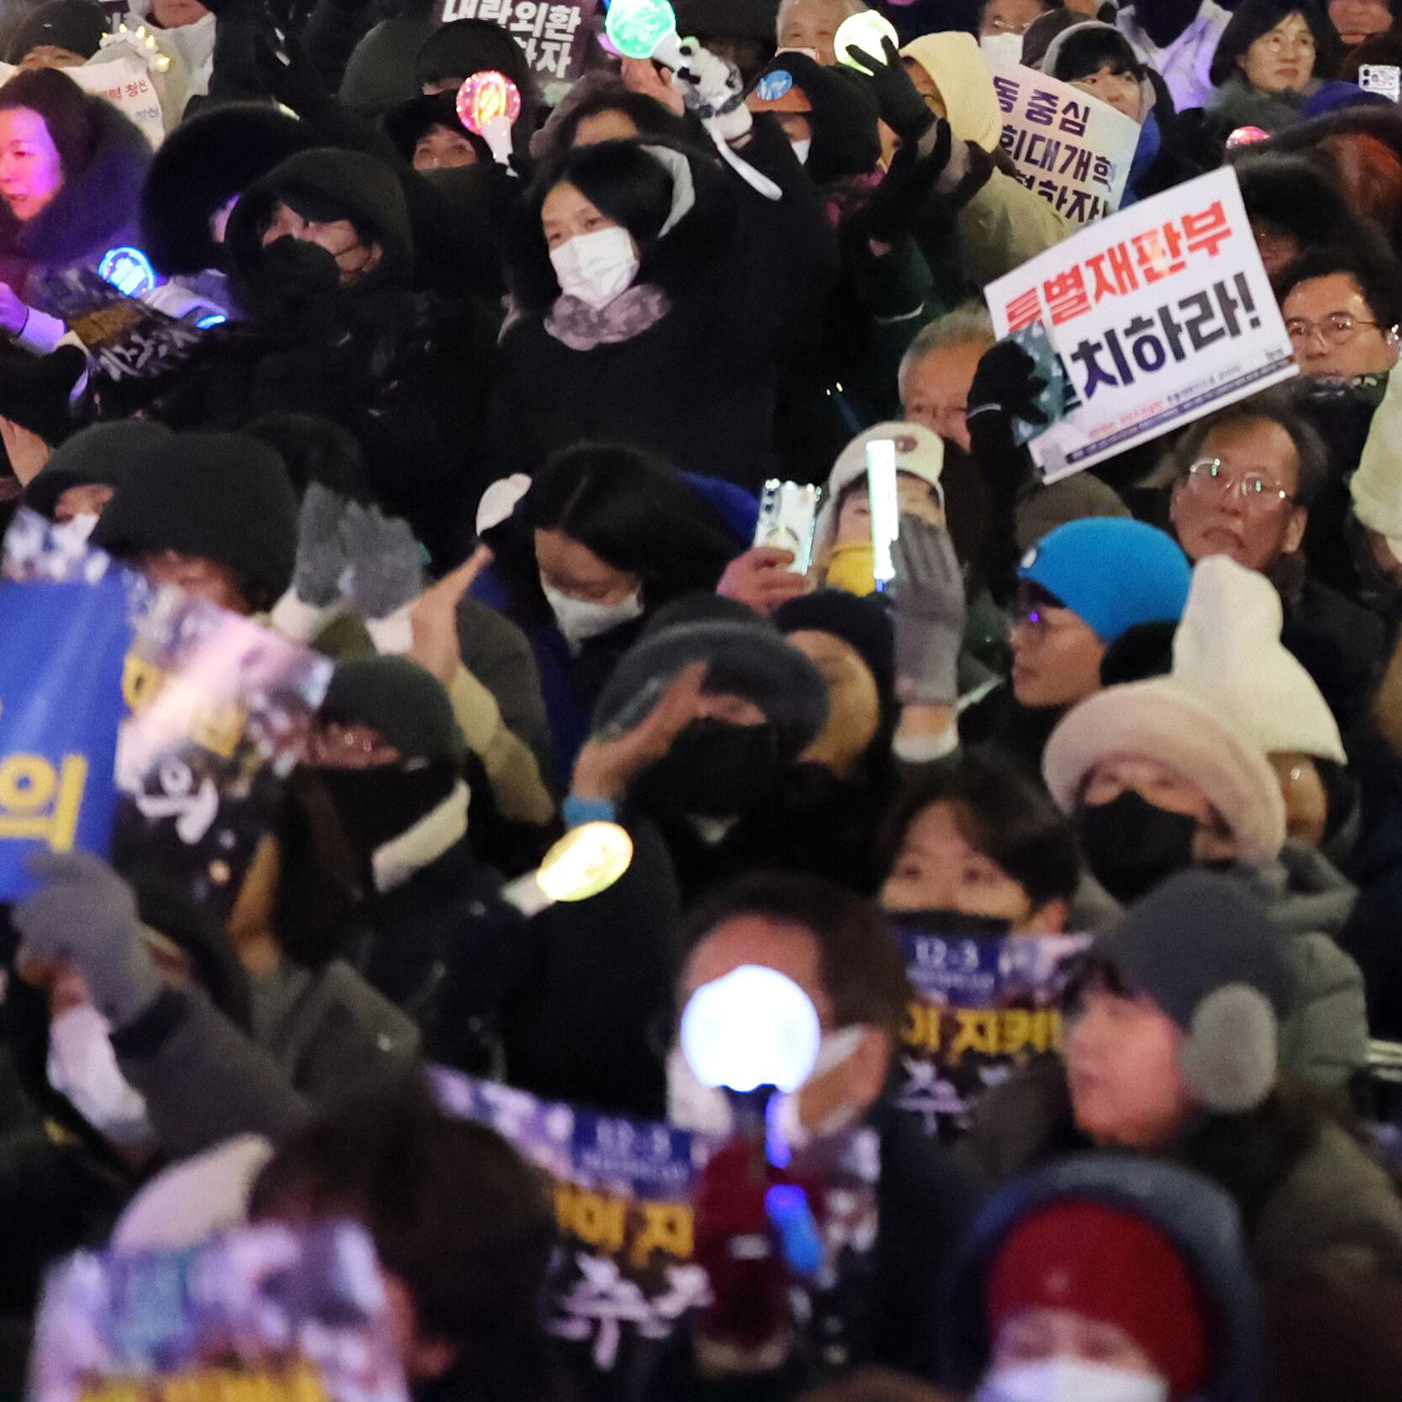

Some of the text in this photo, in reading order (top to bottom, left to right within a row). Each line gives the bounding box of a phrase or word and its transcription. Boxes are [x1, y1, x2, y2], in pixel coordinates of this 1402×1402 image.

[993, 75, 1091, 138] 동 중심
[1000, 124, 1113, 193] 회대개혁
[1005, 199, 1233, 334] 특별재판부
[1062, 270, 1262, 404] 치하라!
